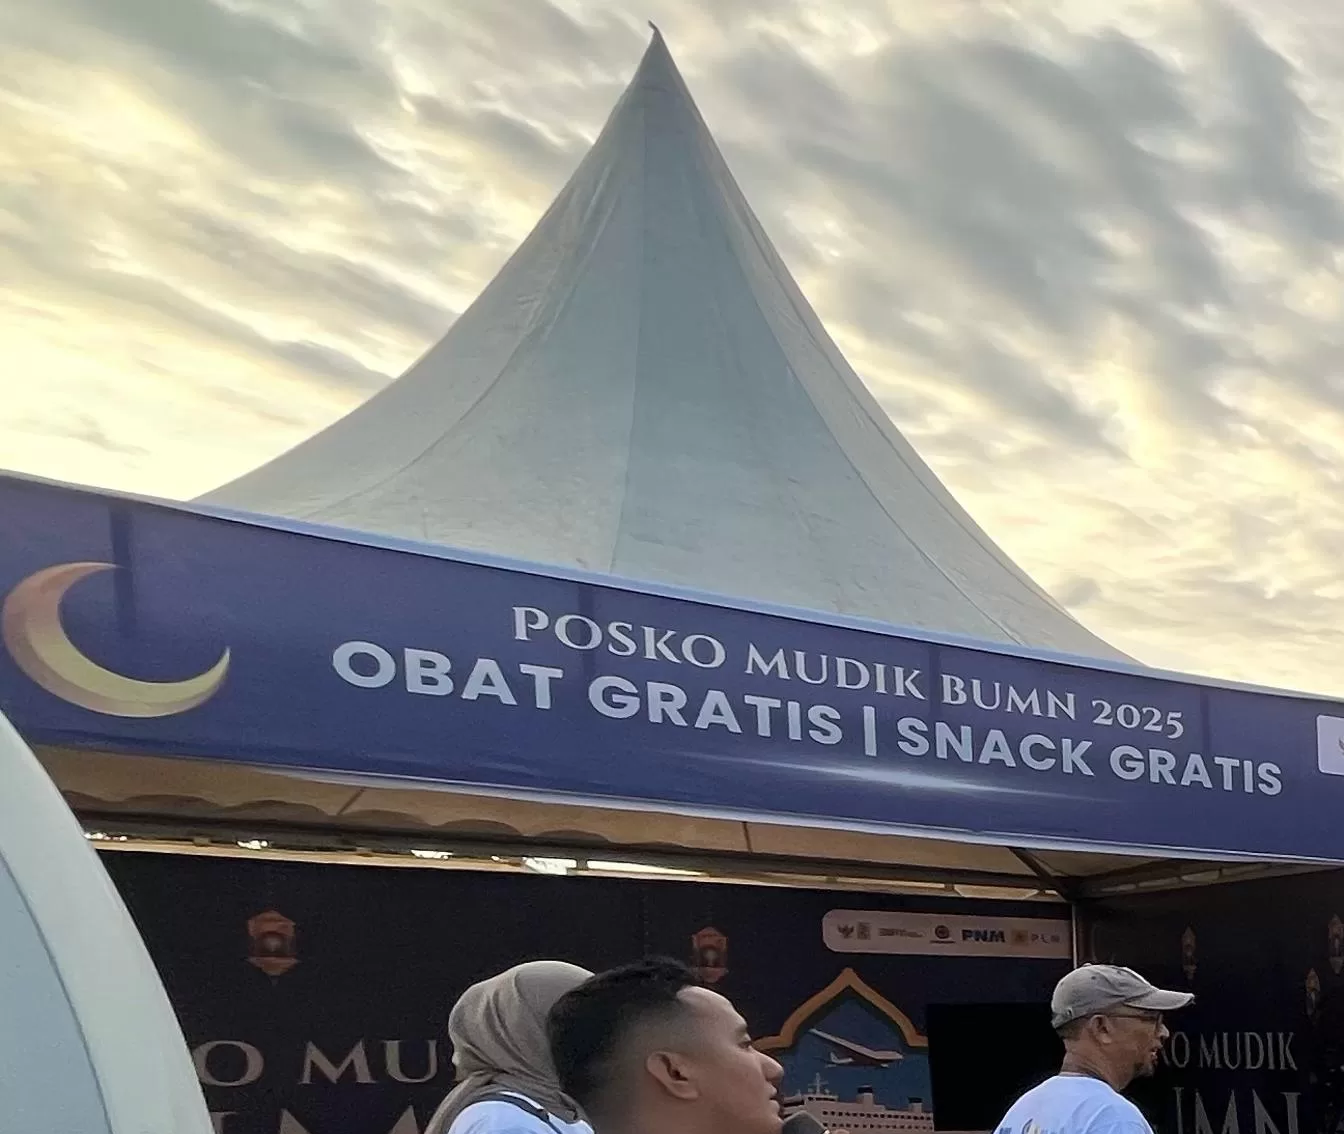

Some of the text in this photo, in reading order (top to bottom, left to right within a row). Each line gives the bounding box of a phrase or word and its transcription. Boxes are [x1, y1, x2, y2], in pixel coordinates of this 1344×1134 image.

[512, 606, 1185, 739] POSKO MUDIK BUMN 2025
[332, 640, 564, 710] OBAT
[588, 675, 844, 746] GRATIS
[896, 716, 1096, 776] SNACK
[1109, 745, 1284, 796] GRATIS
[962, 929, 1005, 943] PNM
[1199, 1031, 1299, 1071] MUDIK
